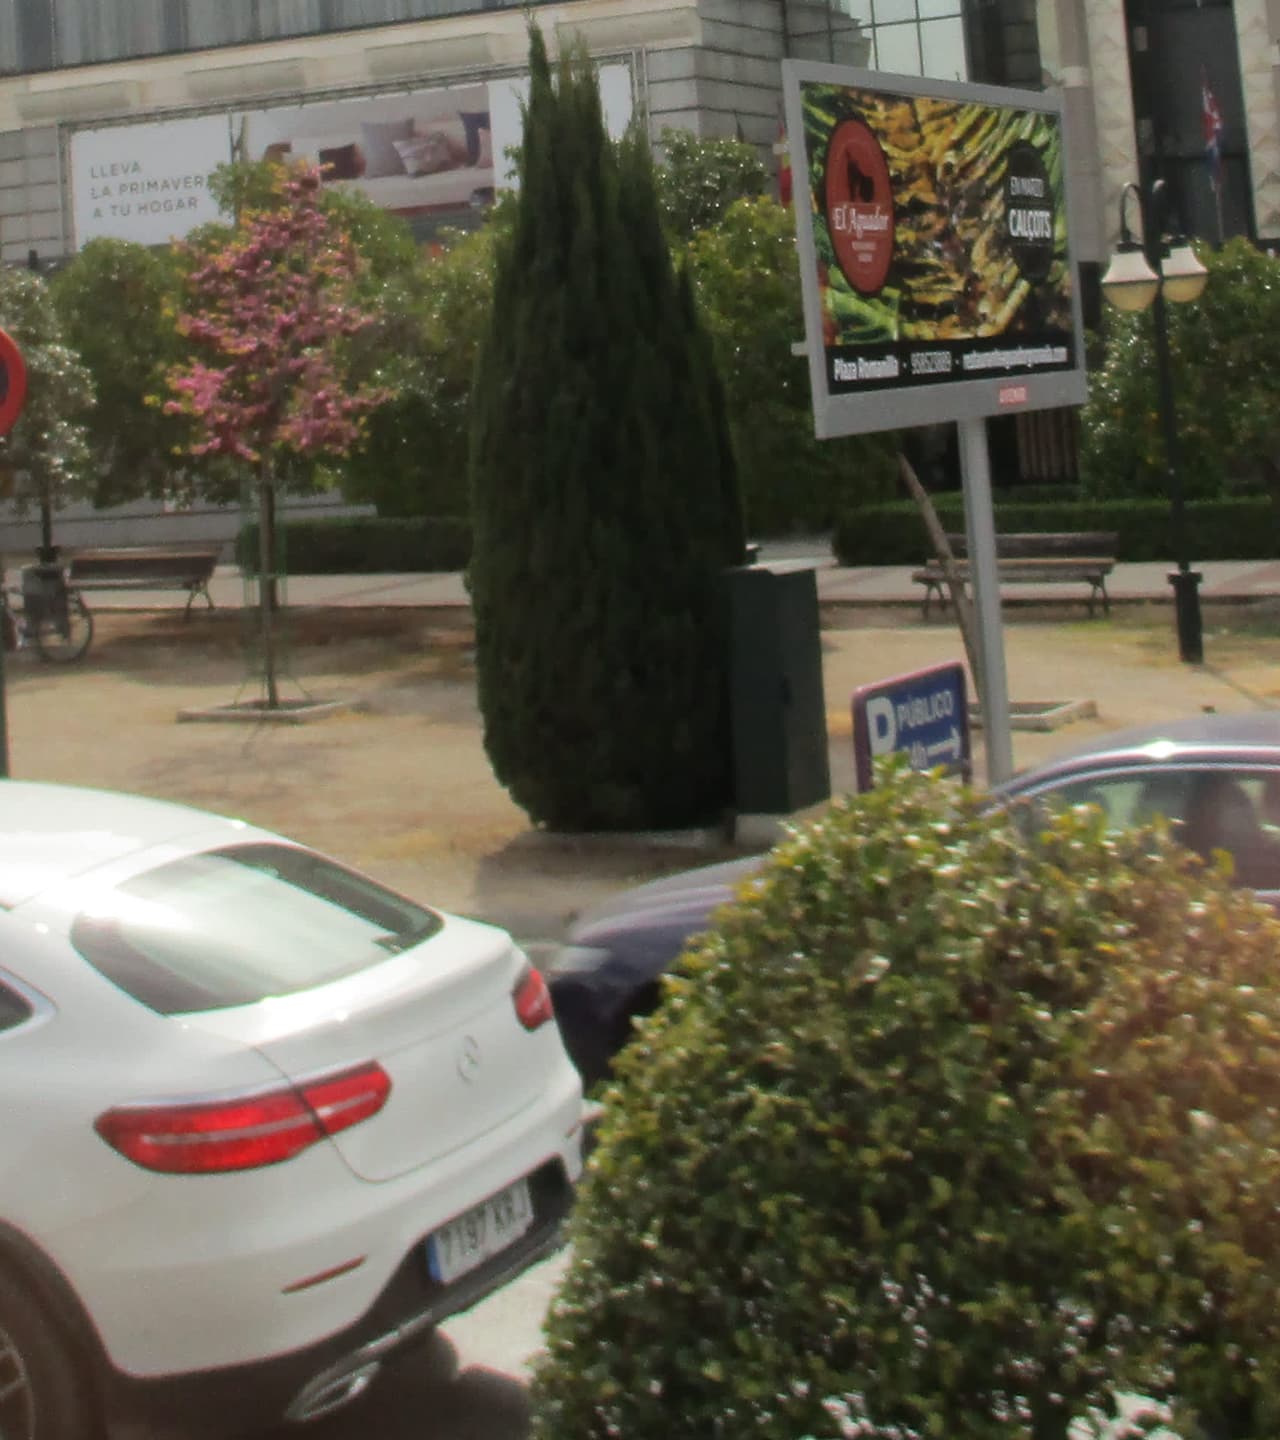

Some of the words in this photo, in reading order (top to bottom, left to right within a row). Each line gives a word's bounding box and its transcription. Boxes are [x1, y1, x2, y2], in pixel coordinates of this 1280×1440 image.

[91, 161, 140, 178] LLEVA
[91, 186, 112, 199] LA
[119, 175, 210, 195] PRIMAVER
[93, 207, 103, 218] A
[111, 204, 131, 216] TU
[138, 197, 198, 214] HOGAR
[1009, 209, 1051, 241] CALÇOTS
